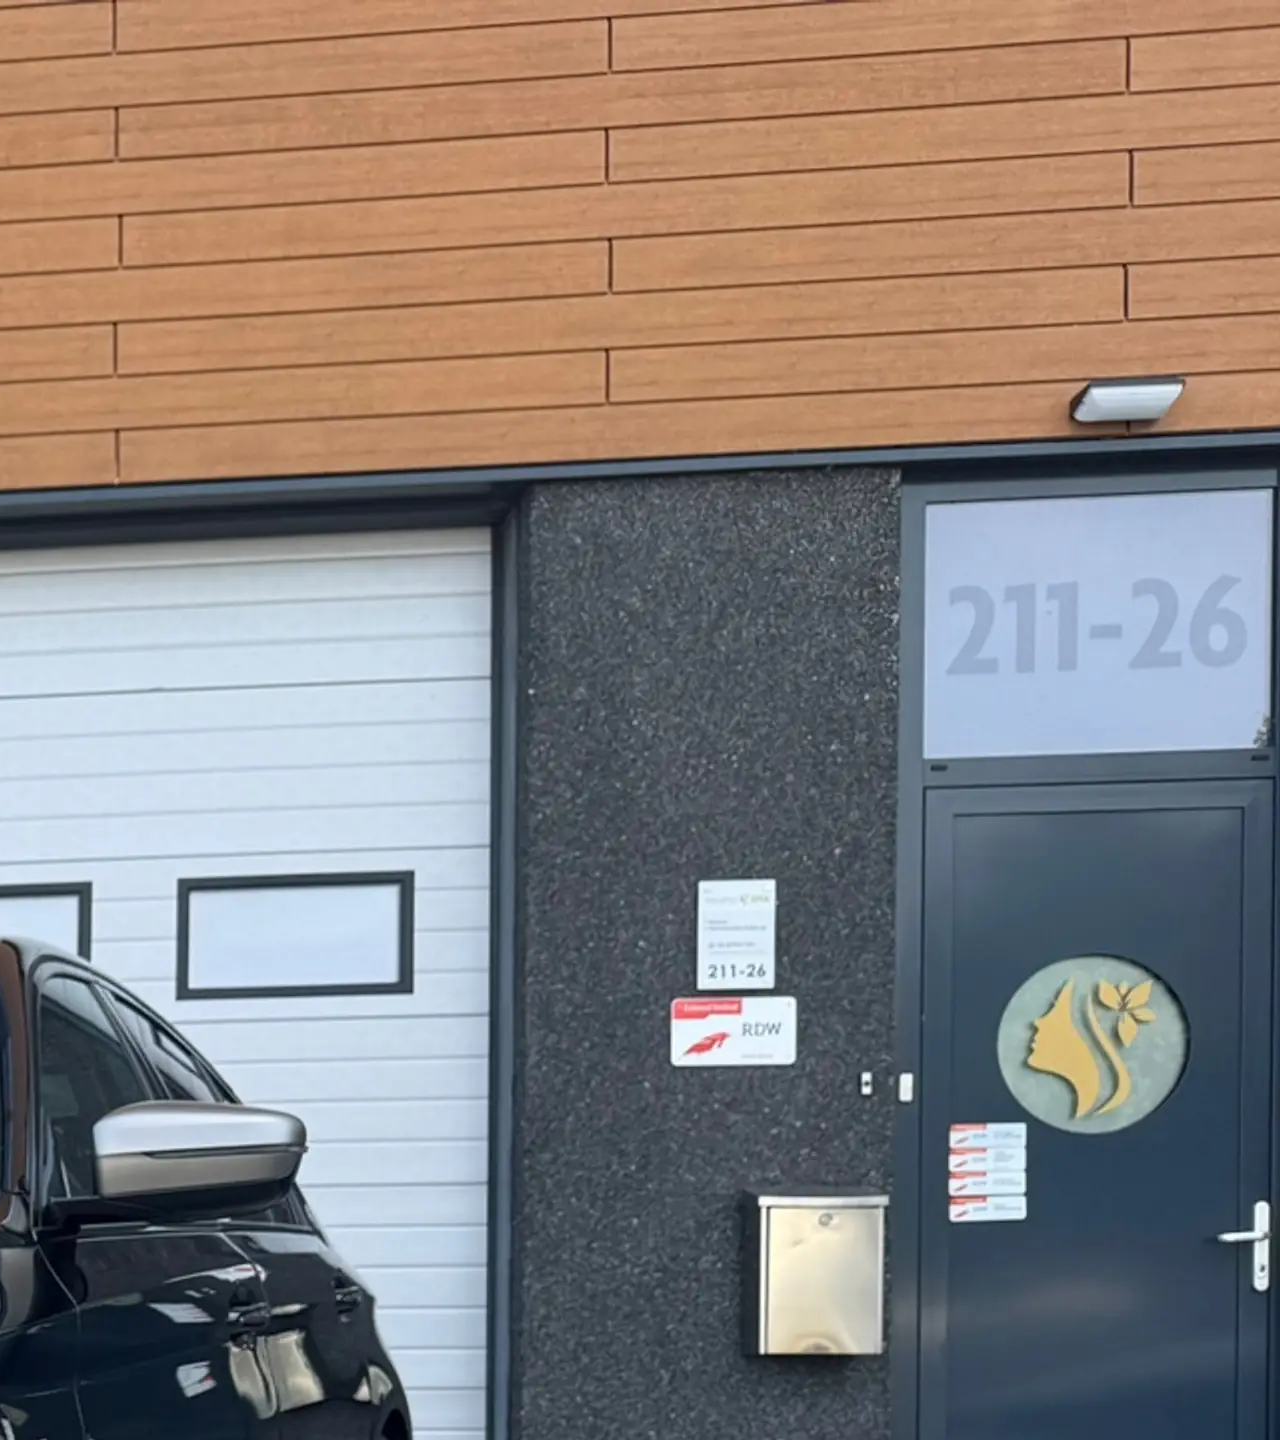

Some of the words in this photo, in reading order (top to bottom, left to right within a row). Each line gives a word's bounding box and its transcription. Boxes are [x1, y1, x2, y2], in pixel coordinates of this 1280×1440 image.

[945, 573, 1248, 676] 211-26
[707, 962, 767, 979] 211-26
[741, 1020, 783, 1037] RDW
